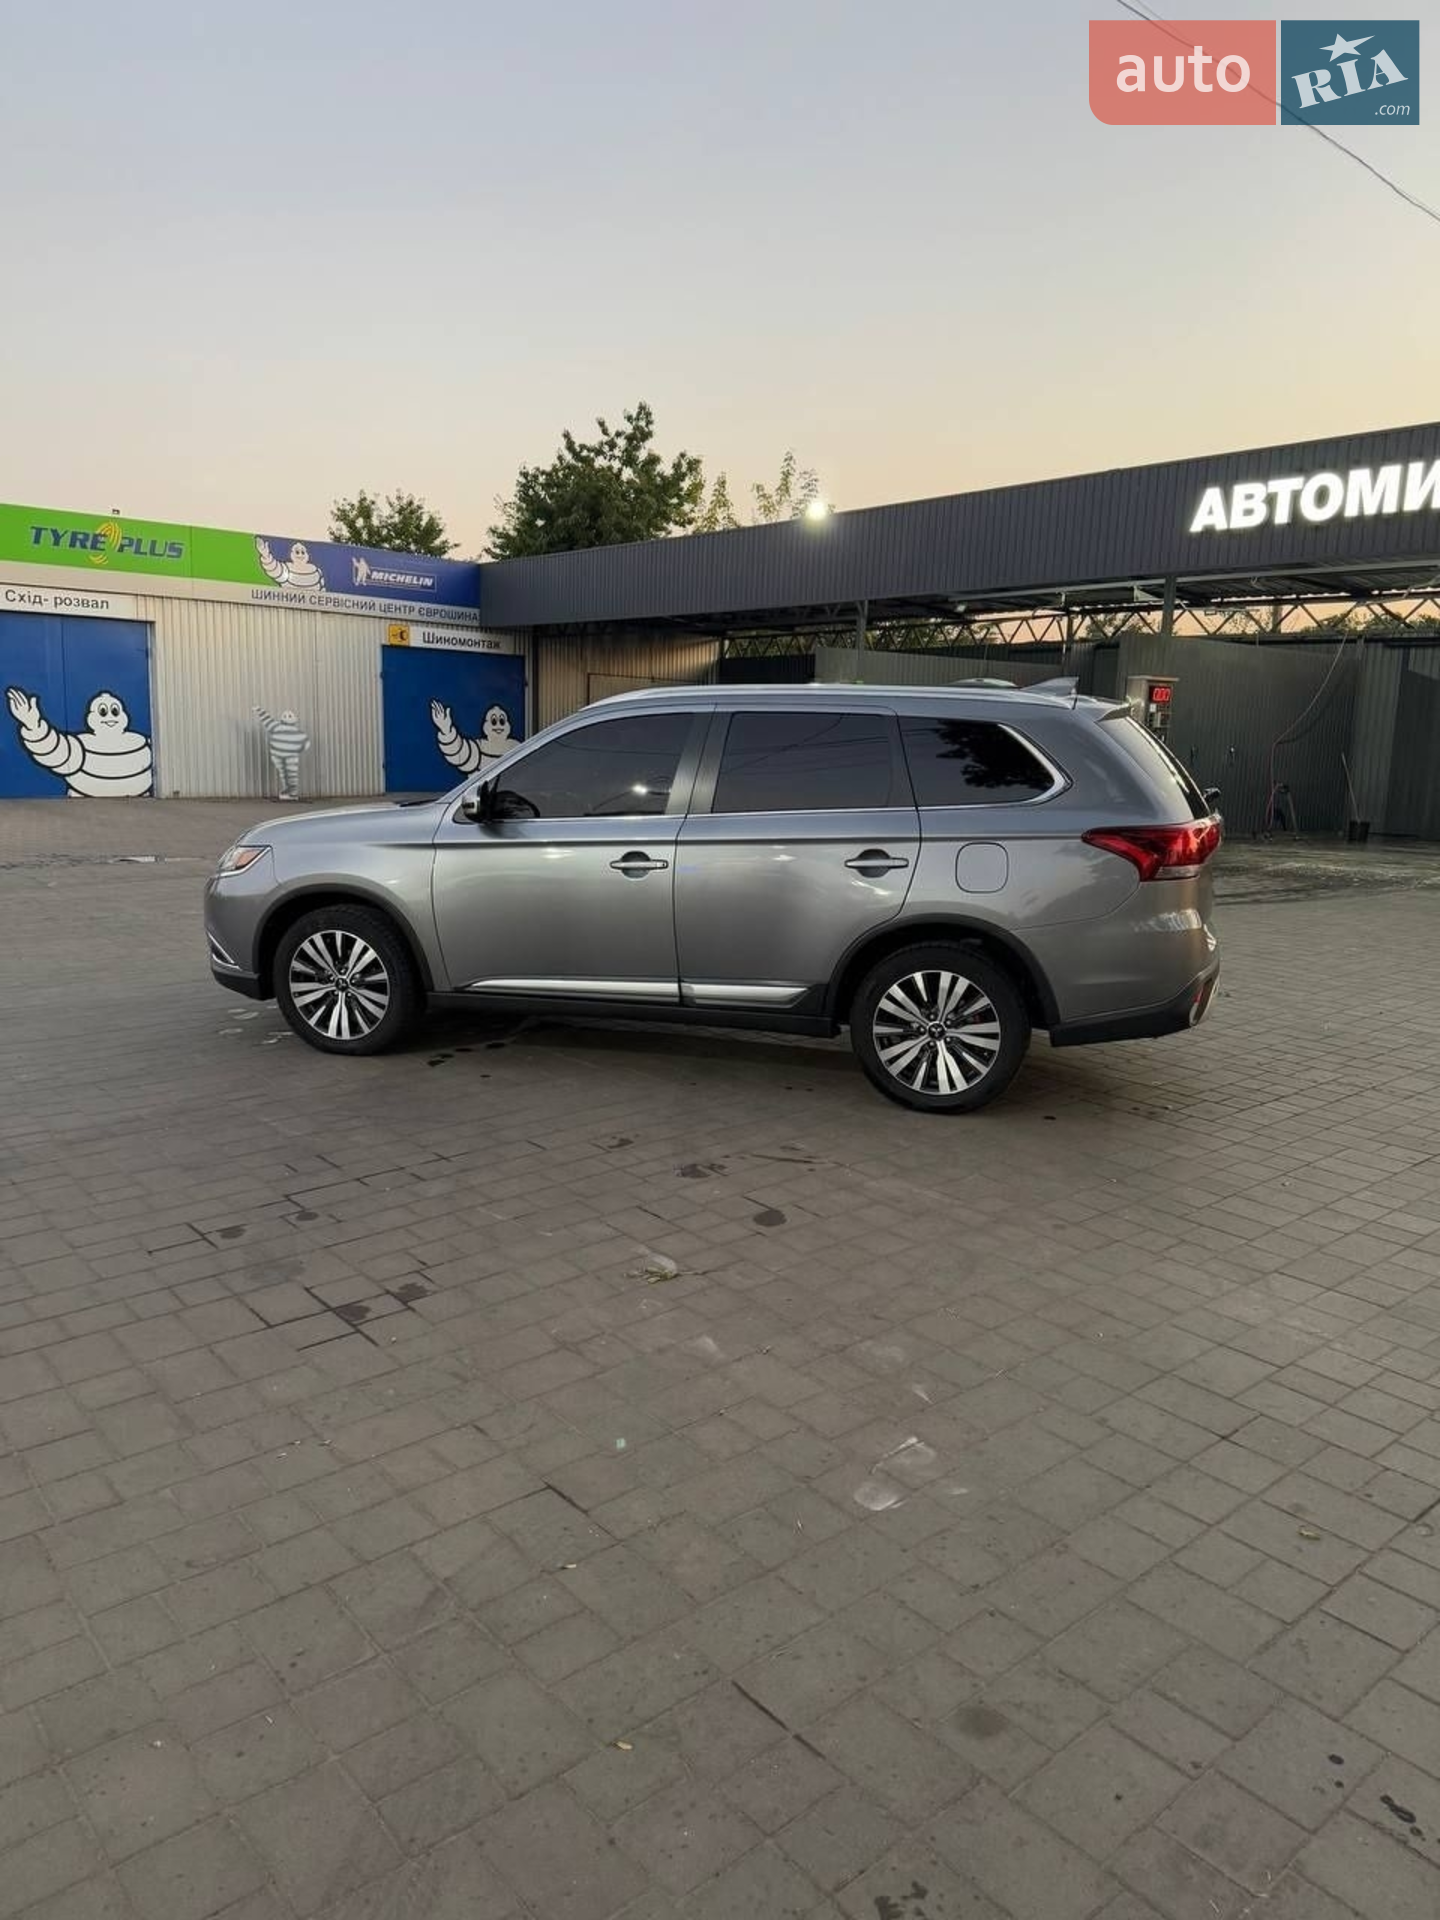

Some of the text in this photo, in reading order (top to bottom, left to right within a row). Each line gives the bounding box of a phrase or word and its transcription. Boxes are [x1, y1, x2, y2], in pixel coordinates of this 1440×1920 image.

[1189, 459, 1440, 533] АВТОМИ
[30, 525, 184, 559] TYRE PLUS
[371, 571, 434, 587] MICHELIN
[53, 595, 109, 610] розвал
[251, 588, 306, 604] ШИННИЙ
[309, 595, 376, 612] СЕРВІСНИЙ
[379, 603, 415, 615] ЦЕНТР
[422, 631, 500, 650] Шиномонтаж
